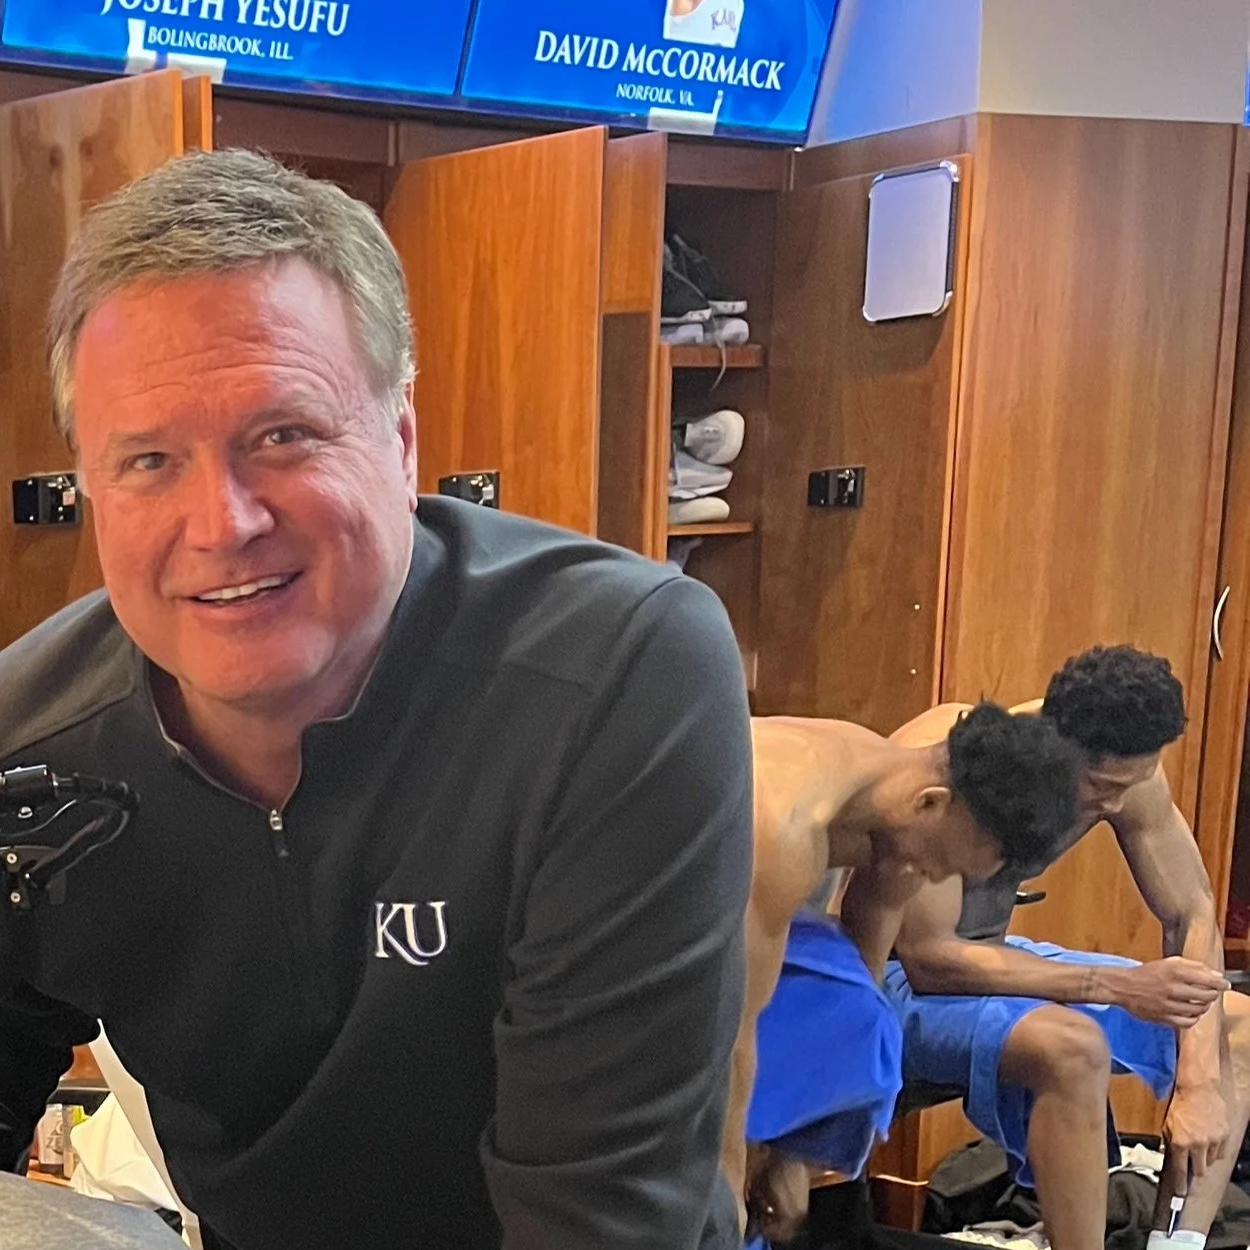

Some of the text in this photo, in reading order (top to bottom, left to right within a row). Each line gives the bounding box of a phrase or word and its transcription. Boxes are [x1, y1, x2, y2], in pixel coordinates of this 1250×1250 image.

[236, 0, 350, 36] YESUFU
[534, 30, 619, 70] DAVID
[375, 901, 447, 966] KU
